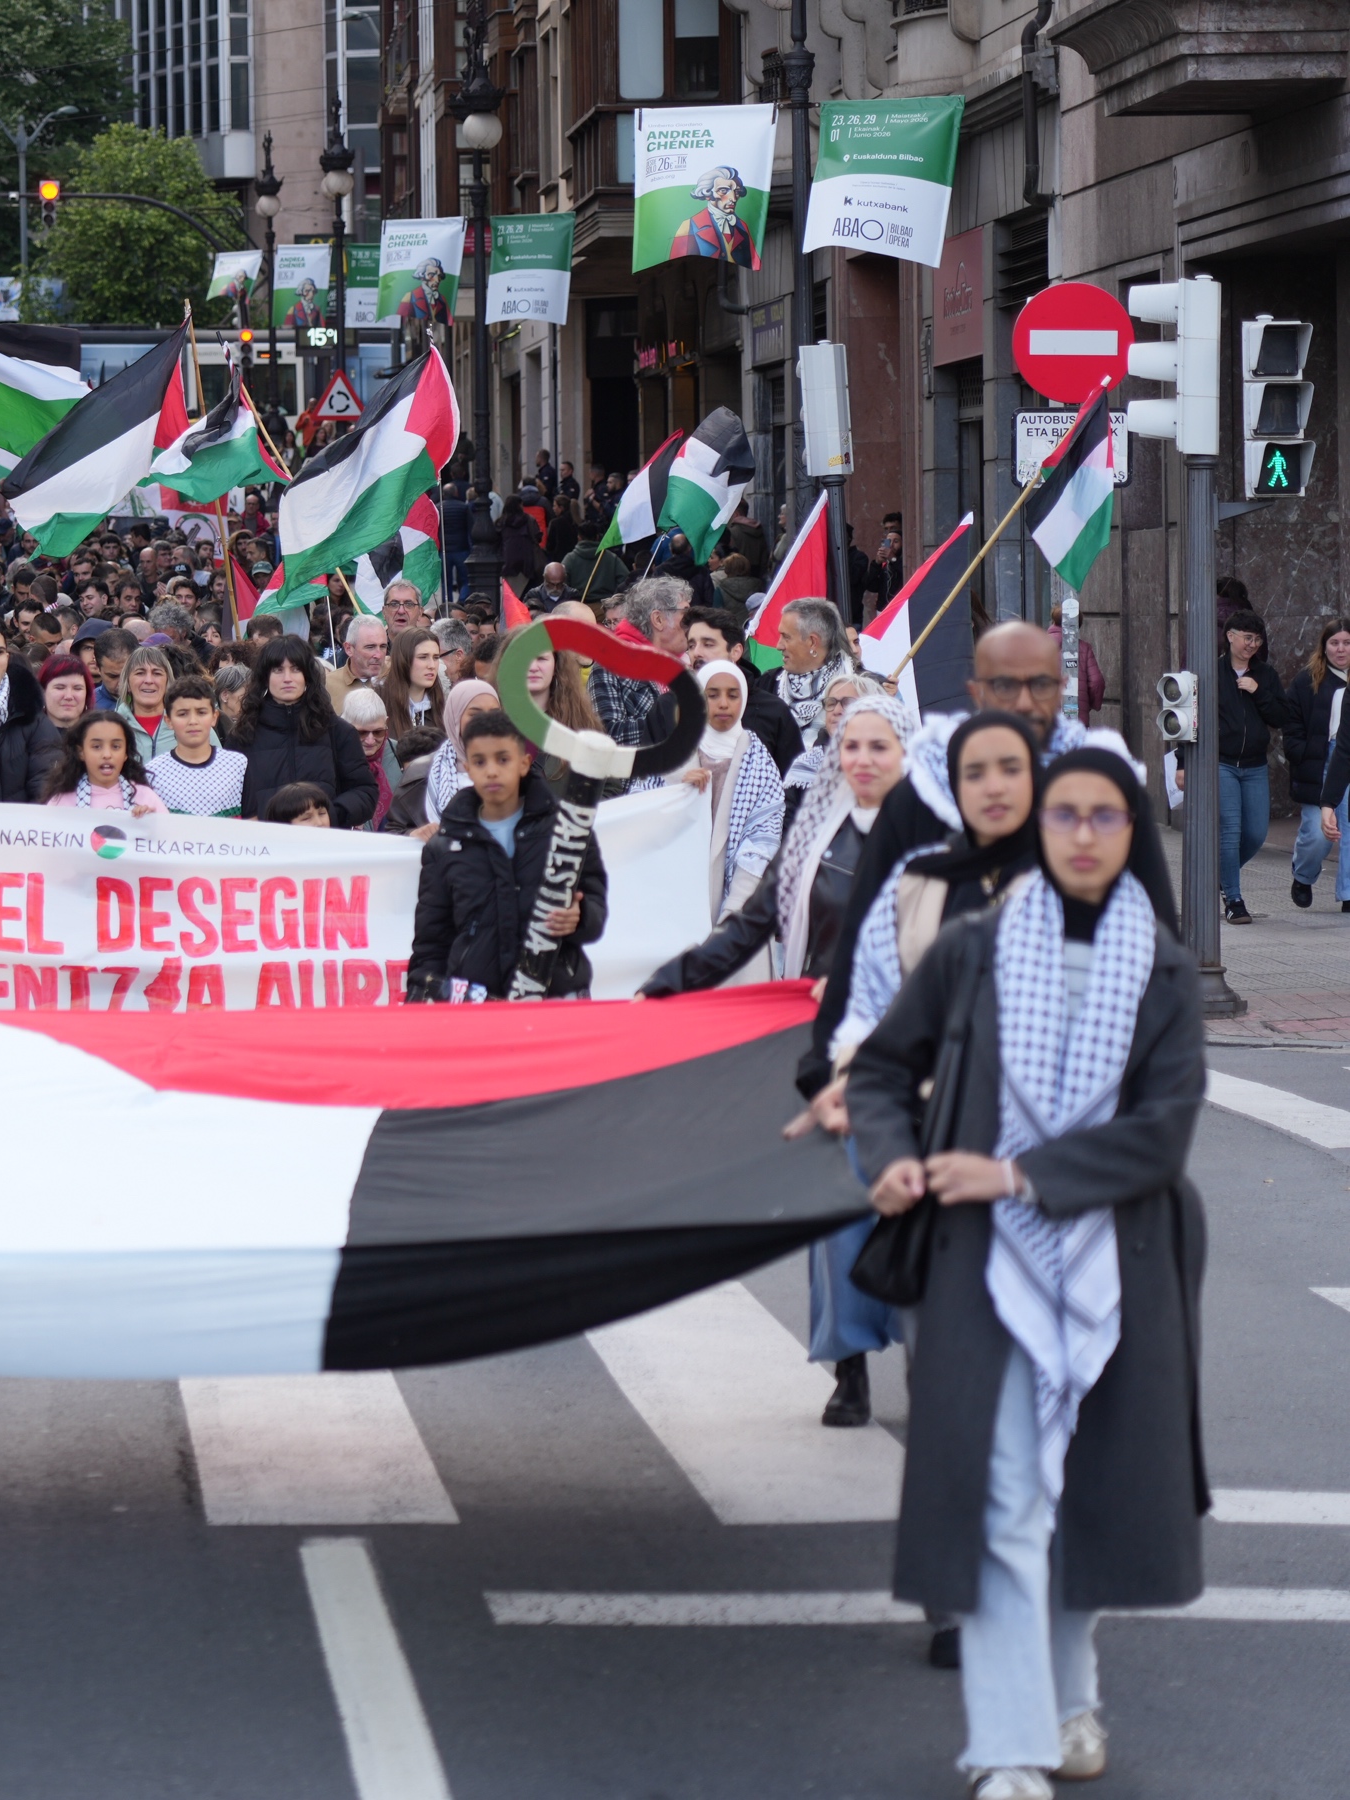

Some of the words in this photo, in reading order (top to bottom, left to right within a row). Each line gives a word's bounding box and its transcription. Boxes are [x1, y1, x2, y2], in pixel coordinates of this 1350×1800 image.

[647, 129, 712, 141] ANDREA
[646, 139, 715, 152] CHÉNIER
[899, 154, 923, 162] Bilbao
[857, 199, 909, 213] kutxabank
[832, 217, 884, 241] ABAO
[890, 223, 913, 238] BILBAO
[388, 233, 427, 241] ANDREA
[888, 235, 910, 248] OPERA
[1027, 428, 1048, 437] ETA
[135, 838, 271, 856] ELKARTASUNA
[96, 875, 370, 957] DESEGIN
